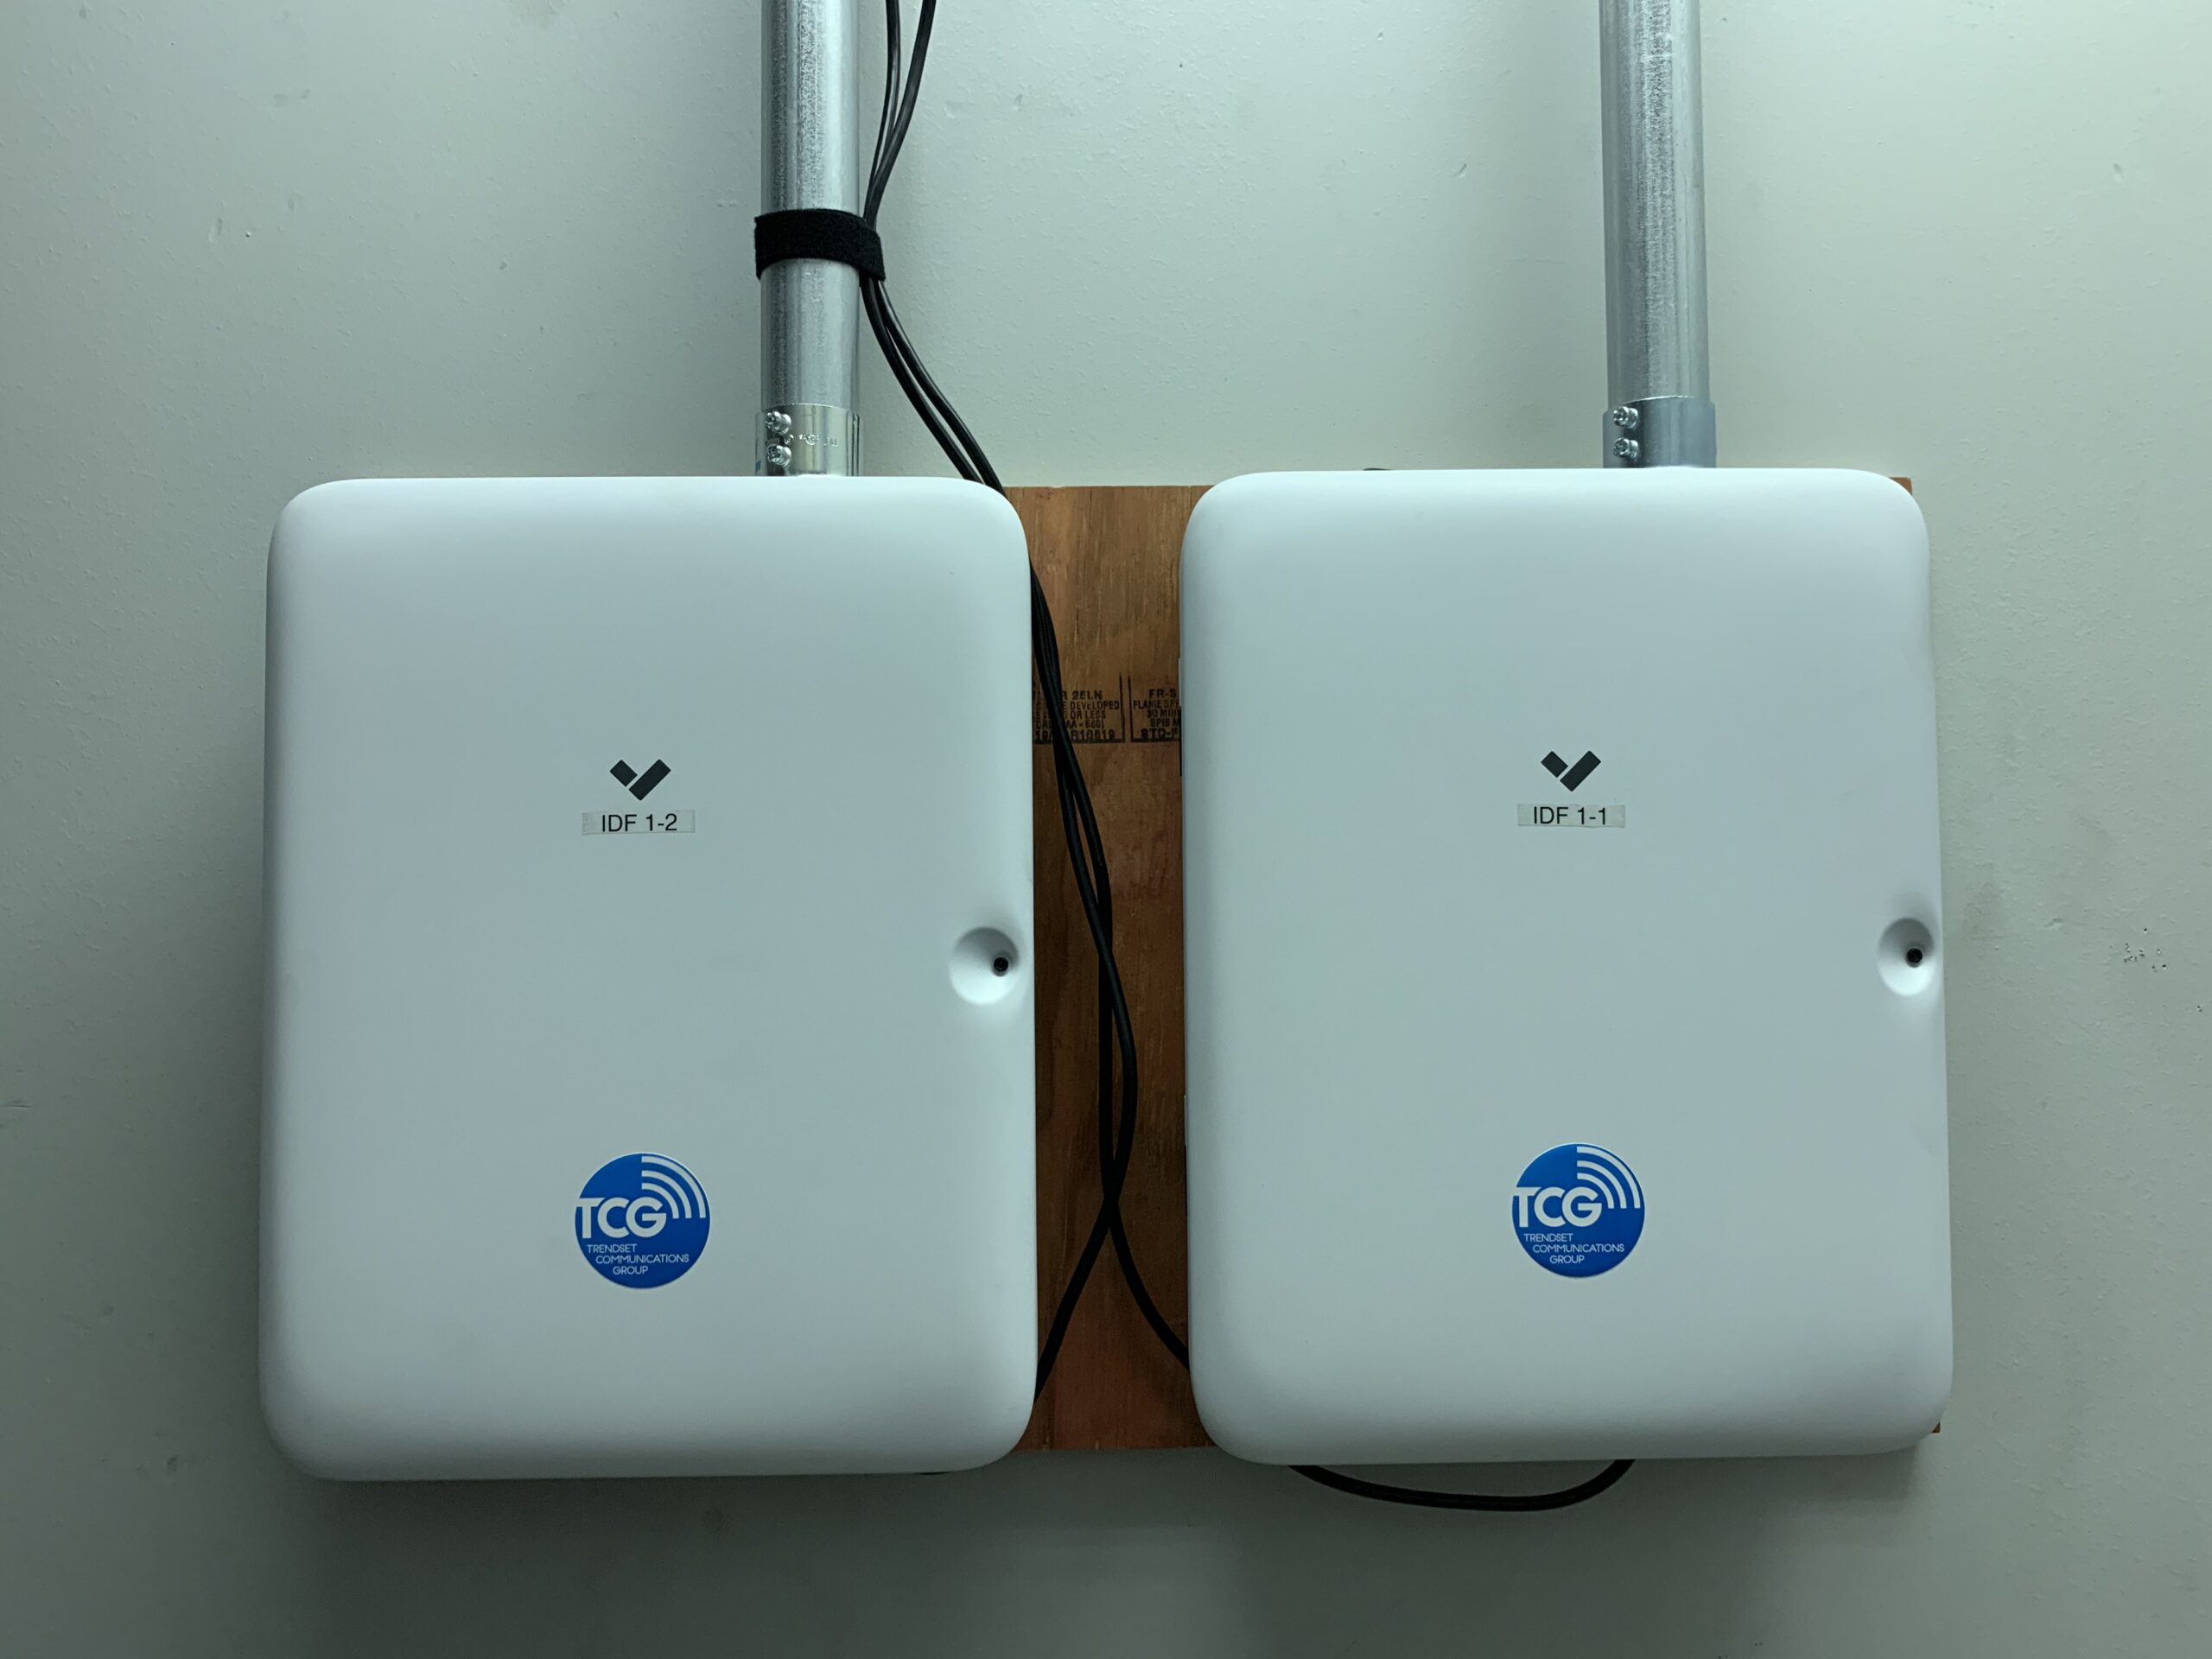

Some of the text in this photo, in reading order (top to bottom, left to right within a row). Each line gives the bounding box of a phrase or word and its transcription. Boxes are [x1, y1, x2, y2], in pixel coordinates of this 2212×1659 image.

[1070, 700, 1120, 710] DEVELOPED
[1133, 699, 1162, 709] FLAME
[1070, 709, 1106, 720] OR LESS
[1534, 806, 1605, 825] IDF 1-1
[602, 813, 677, 832] IDF 1-2
[1513, 1186, 1603, 1228] TCG
[576, 1196, 667, 1239] TCG
[1524, 1233, 1573, 1242] TRENDSET
[587, 1243, 638, 1254] TRENDSET
[1532, 1243, 1625, 1253] COMMUNICATIONS
[595, 1254, 690, 1265] COMMUNICATIONS
[1549, 1255, 1585, 1264] GROUP
[613, 1265, 649, 1275] GROUP
